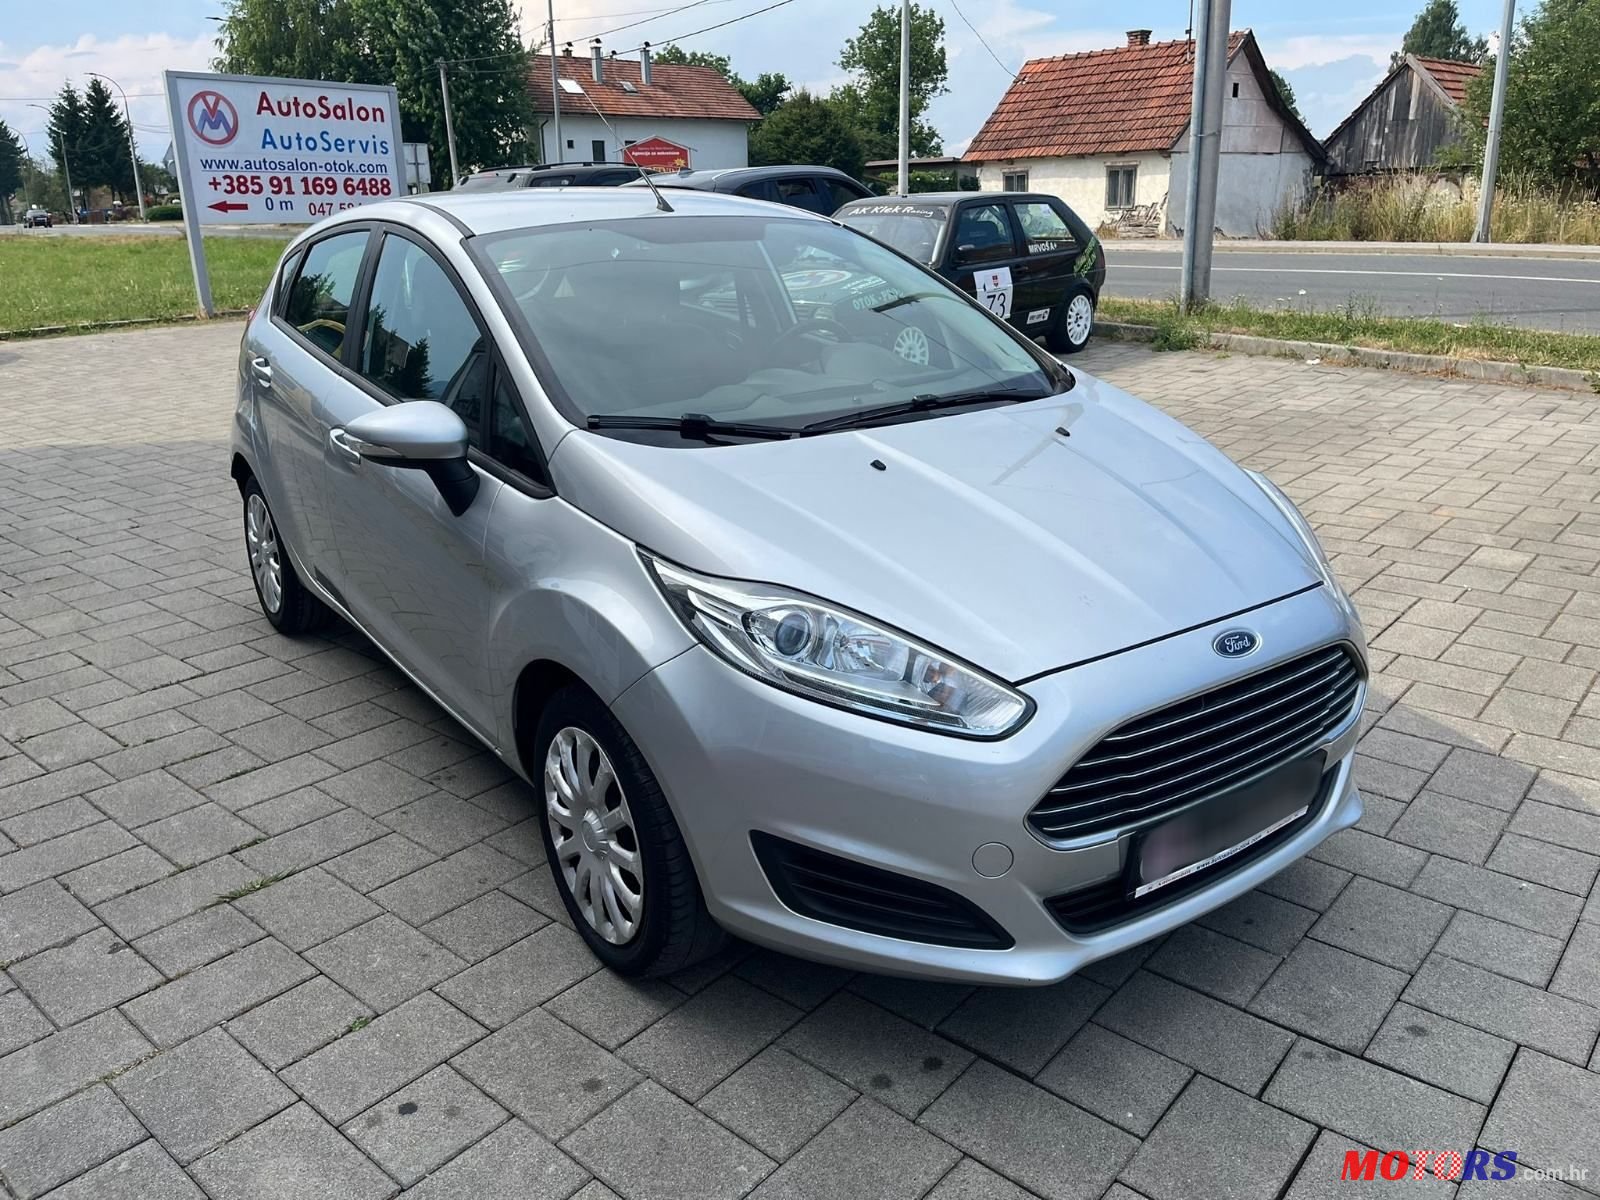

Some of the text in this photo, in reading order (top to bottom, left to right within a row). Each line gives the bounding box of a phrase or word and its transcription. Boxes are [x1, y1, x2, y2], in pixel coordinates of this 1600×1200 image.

[256, 91, 385, 123] AutoSalon
[261, 128, 389, 155] AutoServis
[200, 158, 388, 174] www.autosalon-otok.com
[208, 174, 392, 196] +385 91 169 6488
[265, 197, 294, 211] 0 m
[308, 202, 333, 216] 047
[848, 206, 871, 216] AK
[986, 292, 1006, 319] 73
[1225, 635, 1251, 653] Ford
